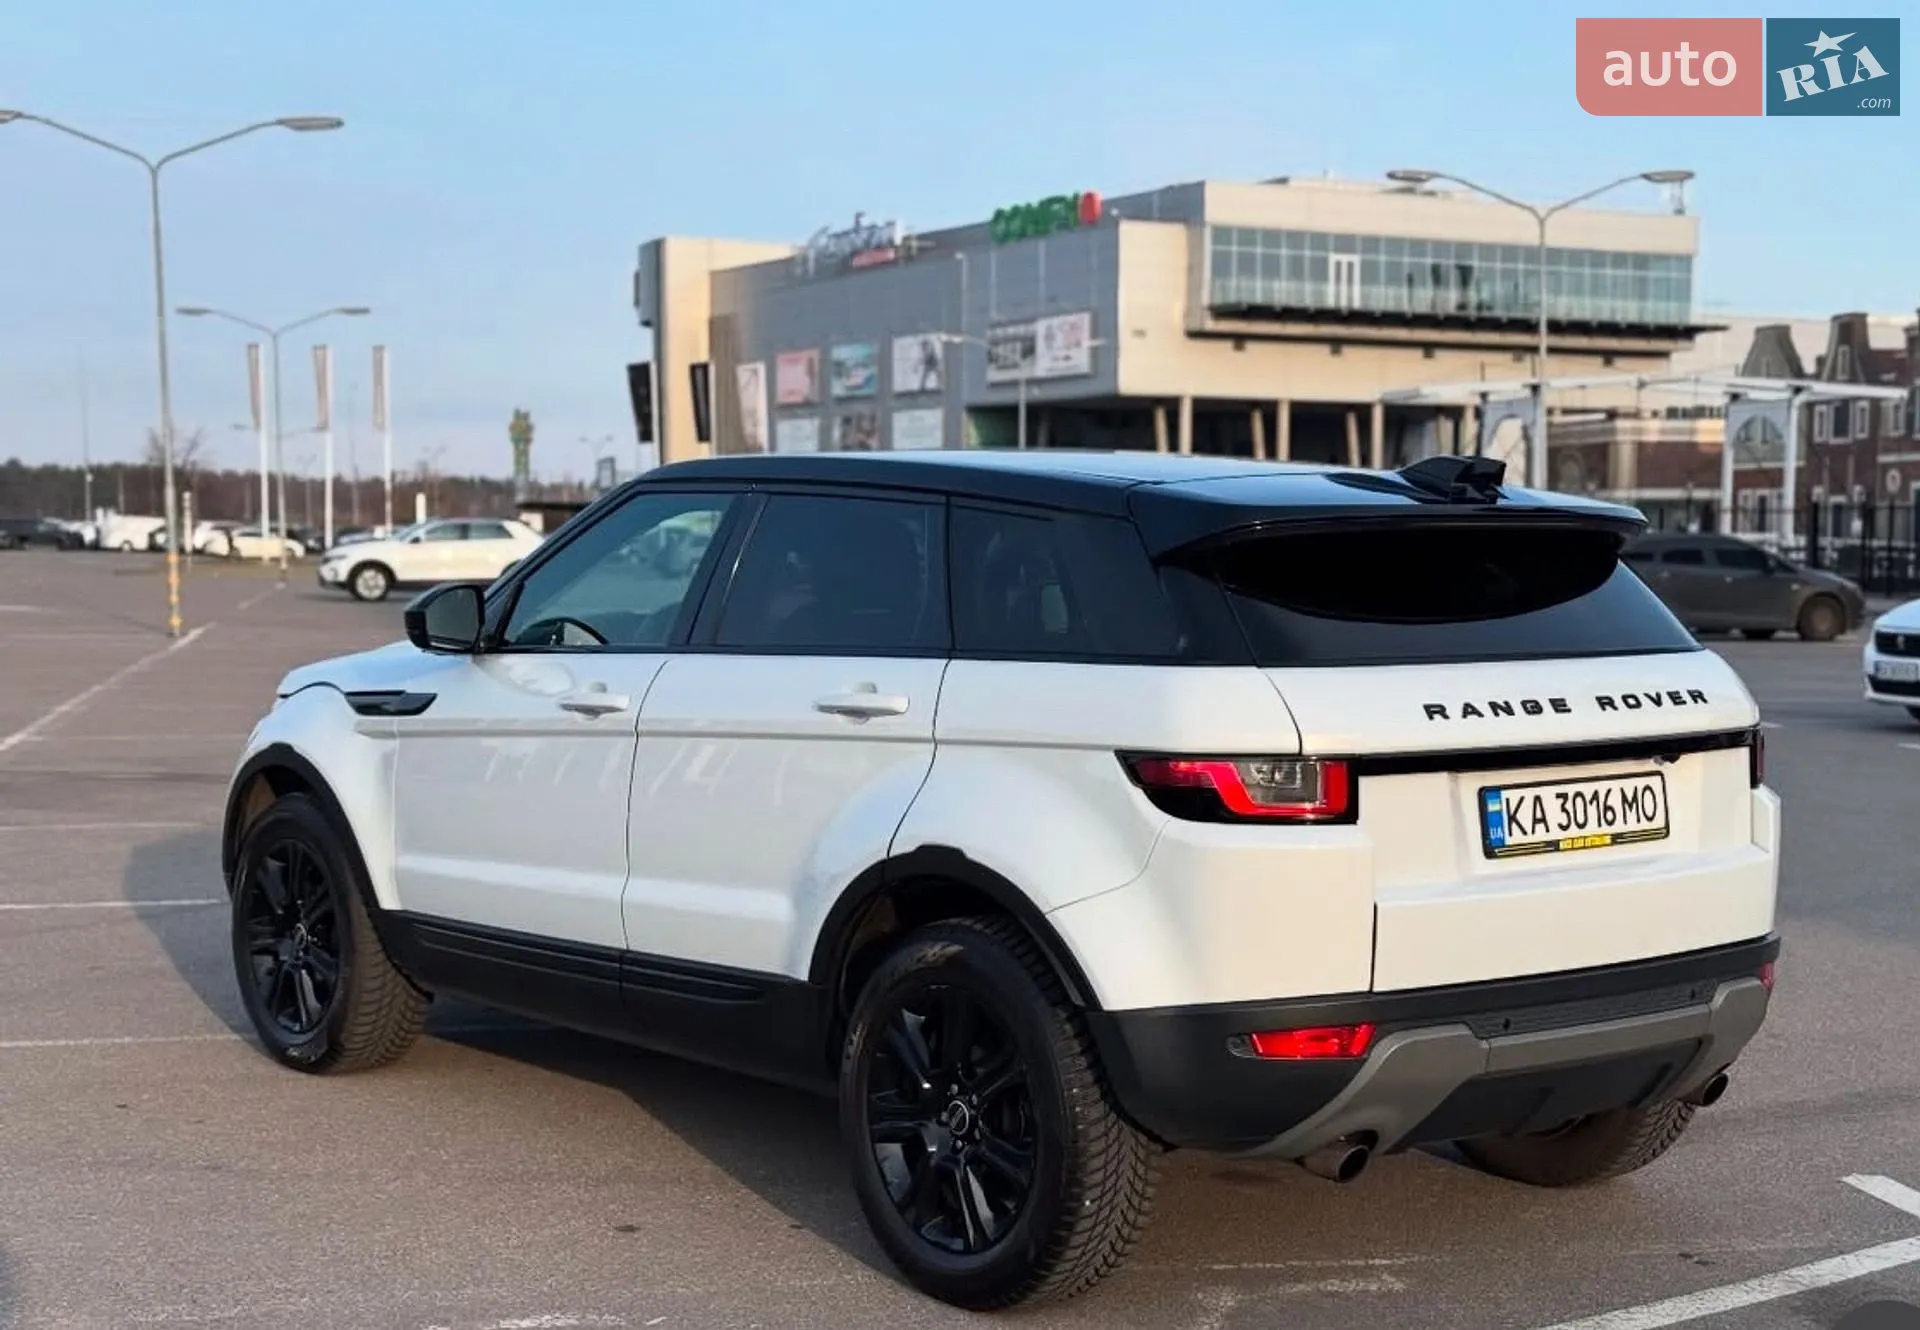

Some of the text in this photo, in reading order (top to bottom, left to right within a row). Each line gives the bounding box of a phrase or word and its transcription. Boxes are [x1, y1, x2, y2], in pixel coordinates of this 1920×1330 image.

[1422, 688, 1709, 721] RANGE ROVER
[1504, 783, 1658, 838] KA 3016 MO
[1489, 826, 1504, 839] UA
